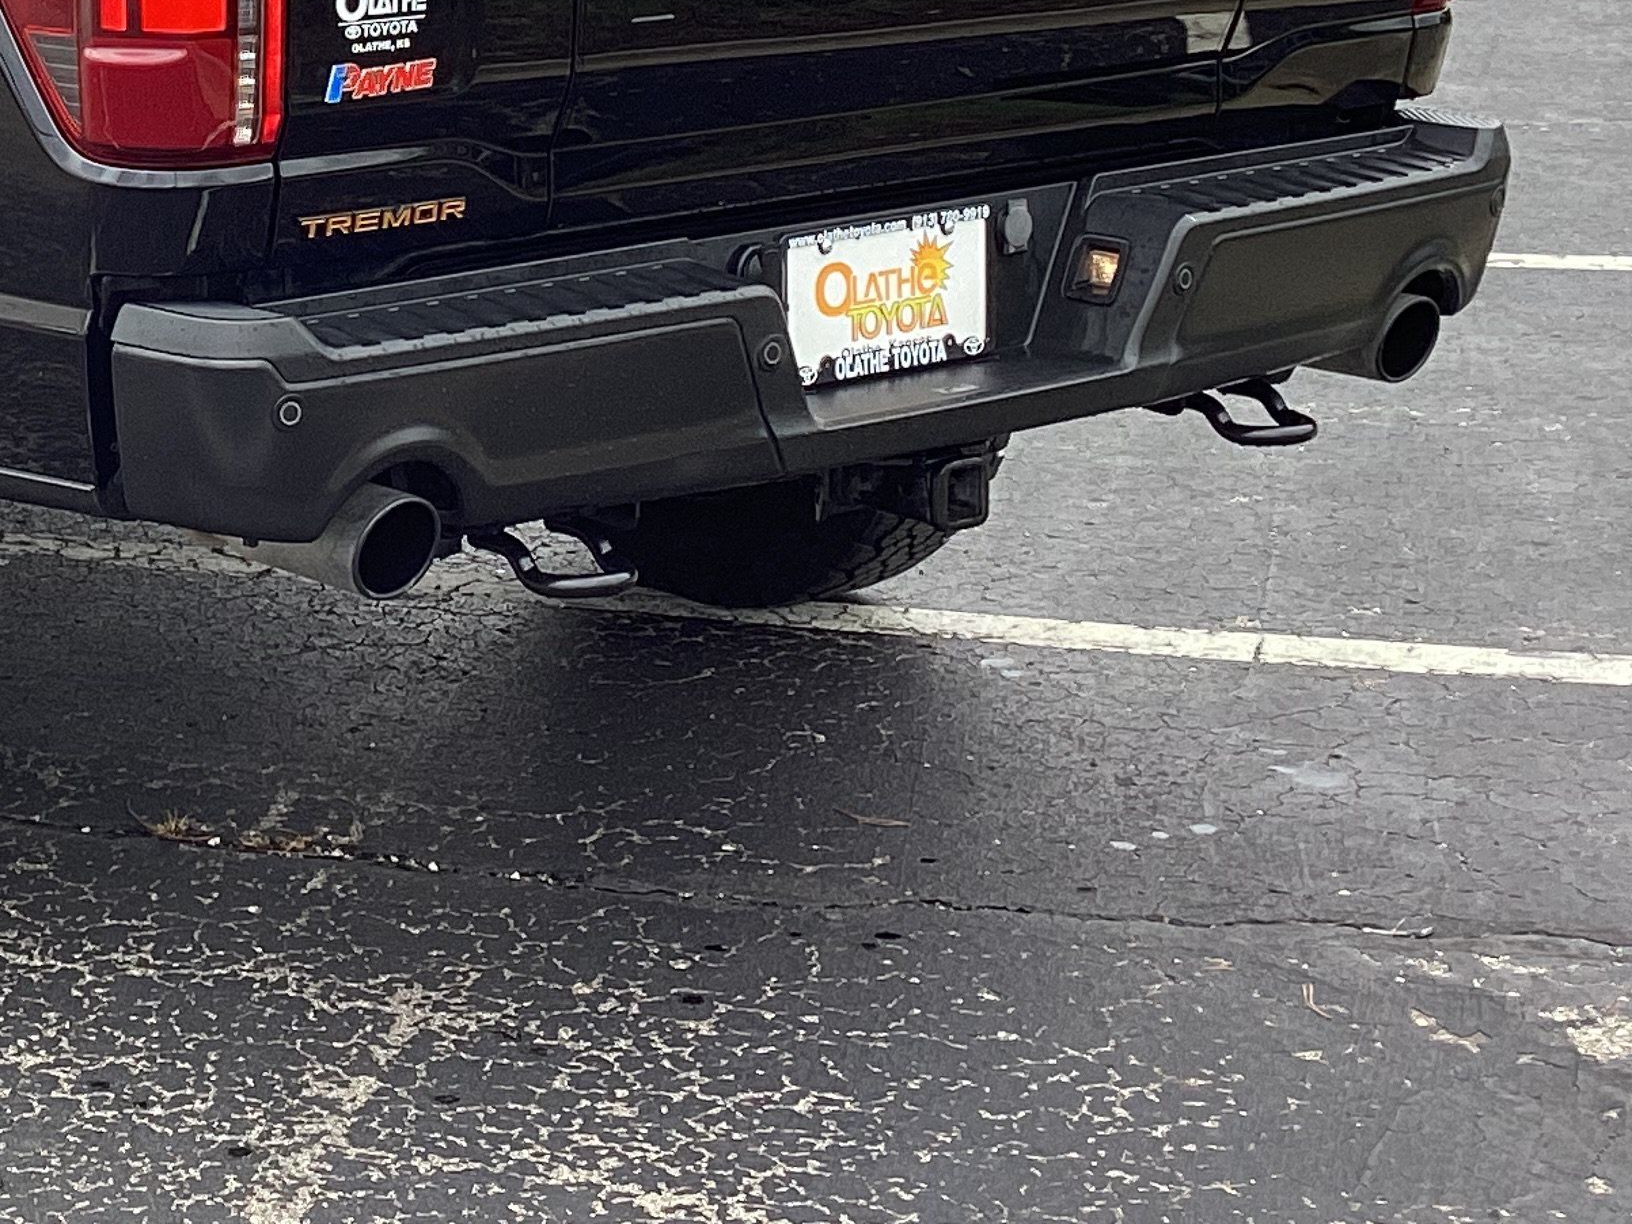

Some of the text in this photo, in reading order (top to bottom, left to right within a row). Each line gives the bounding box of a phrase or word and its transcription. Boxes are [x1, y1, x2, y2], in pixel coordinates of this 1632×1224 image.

[361, 20, 418, 38] TOYOTA
[324, 58, 437, 104] PAYNE
[298, 196, 467, 239] TREMOR
[845, 293, 949, 342] TOYOTA
[834, 339, 948, 381] OLATHE TOYOTA
